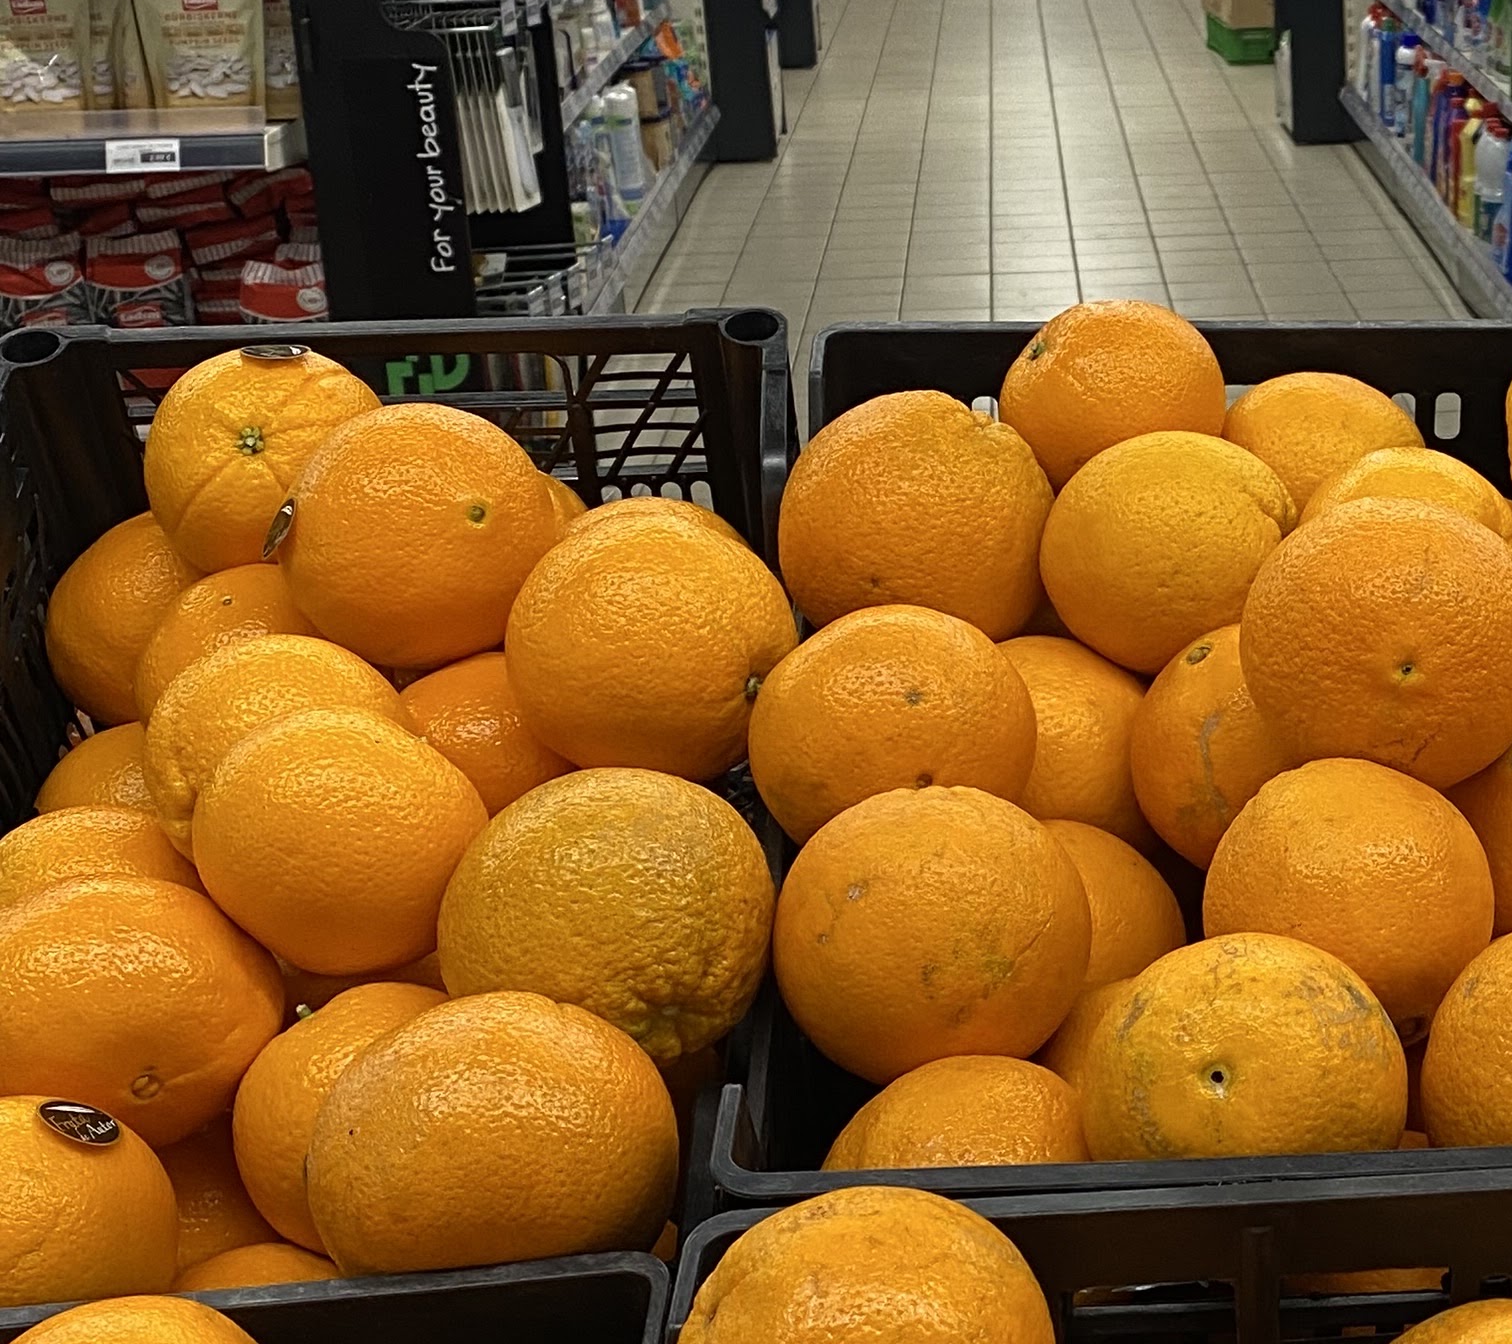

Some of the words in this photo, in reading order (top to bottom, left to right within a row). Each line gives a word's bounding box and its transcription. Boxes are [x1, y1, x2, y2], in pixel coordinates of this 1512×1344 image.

[406, 62, 441, 158] beauty
[426, 166, 457, 221] your
[431, 229, 455, 273] For
[48, 1113, 90, 1131] Fruta
[86, 1118, 116, 1140] Autor
